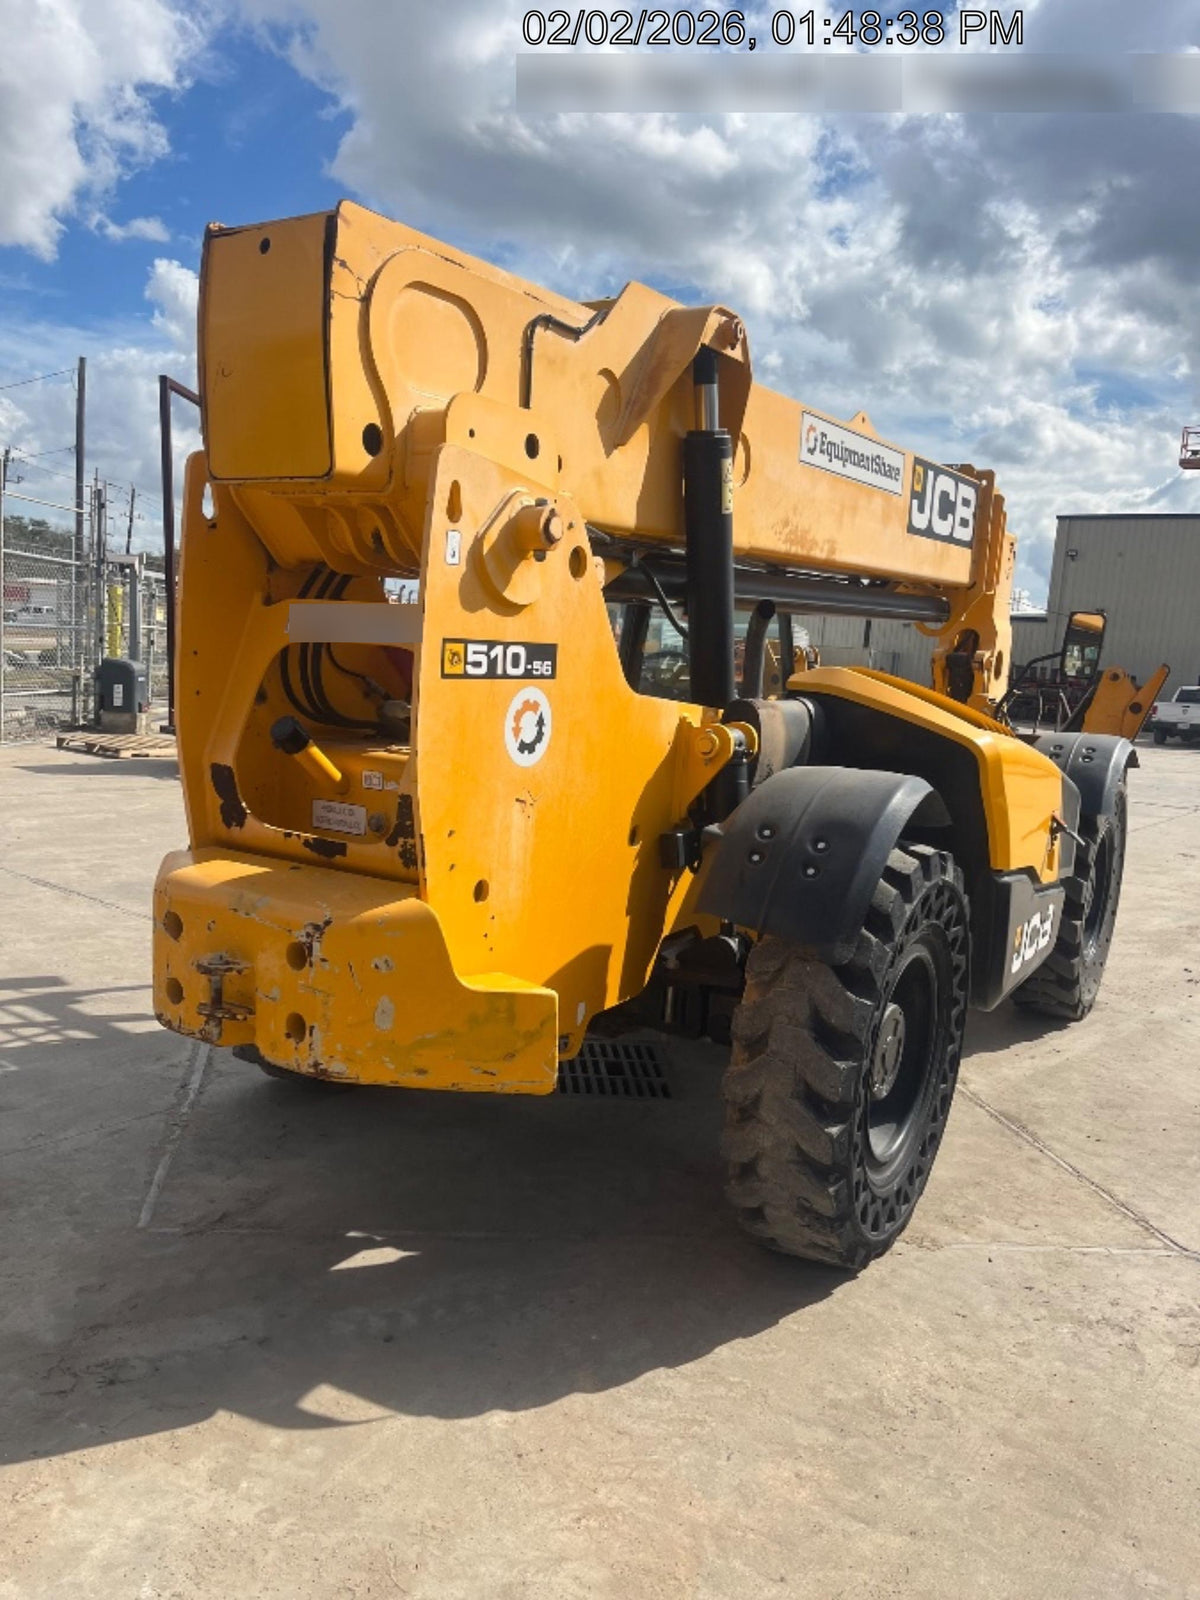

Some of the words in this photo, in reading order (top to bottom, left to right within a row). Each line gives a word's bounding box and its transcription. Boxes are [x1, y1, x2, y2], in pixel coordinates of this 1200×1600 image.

[819, 431, 900, 481] EquipmentShare
[911, 470, 976, 541] JCB
[465, 643, 552, 676] 510-56
